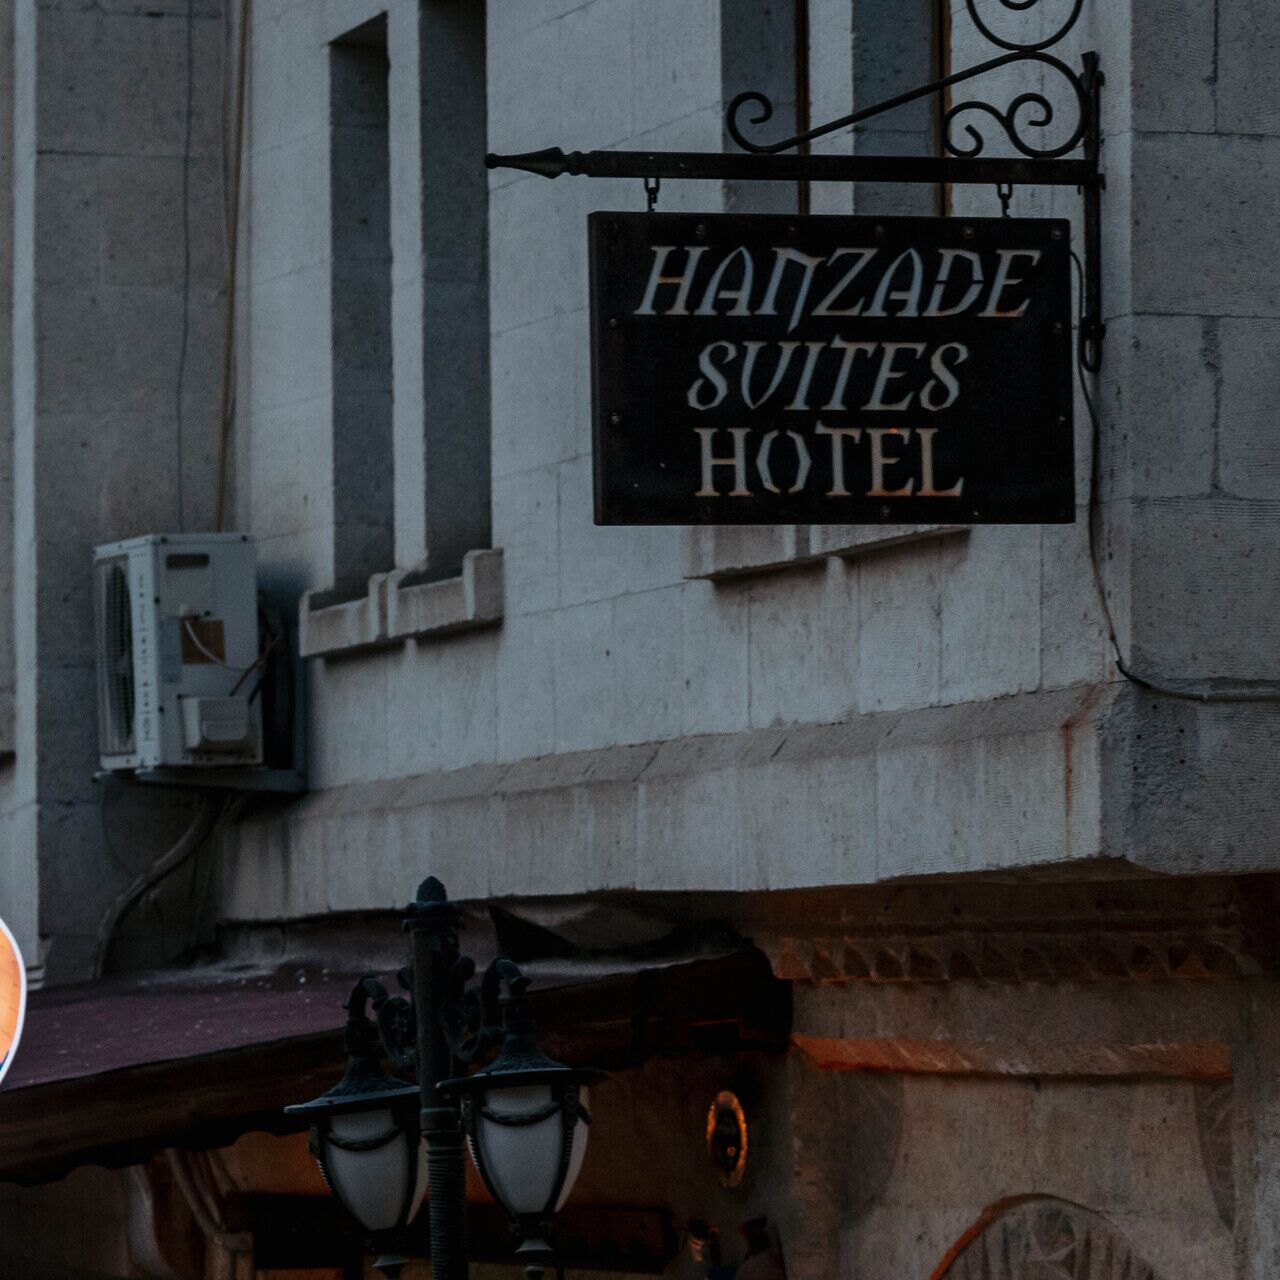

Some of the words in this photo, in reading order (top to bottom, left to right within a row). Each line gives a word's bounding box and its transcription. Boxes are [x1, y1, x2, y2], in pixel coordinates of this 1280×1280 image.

[633, 246, 1041, 333] HANZADE
[687, 334, 969, 411] SUITES
[693, 420, 964, 497] HOTEL
